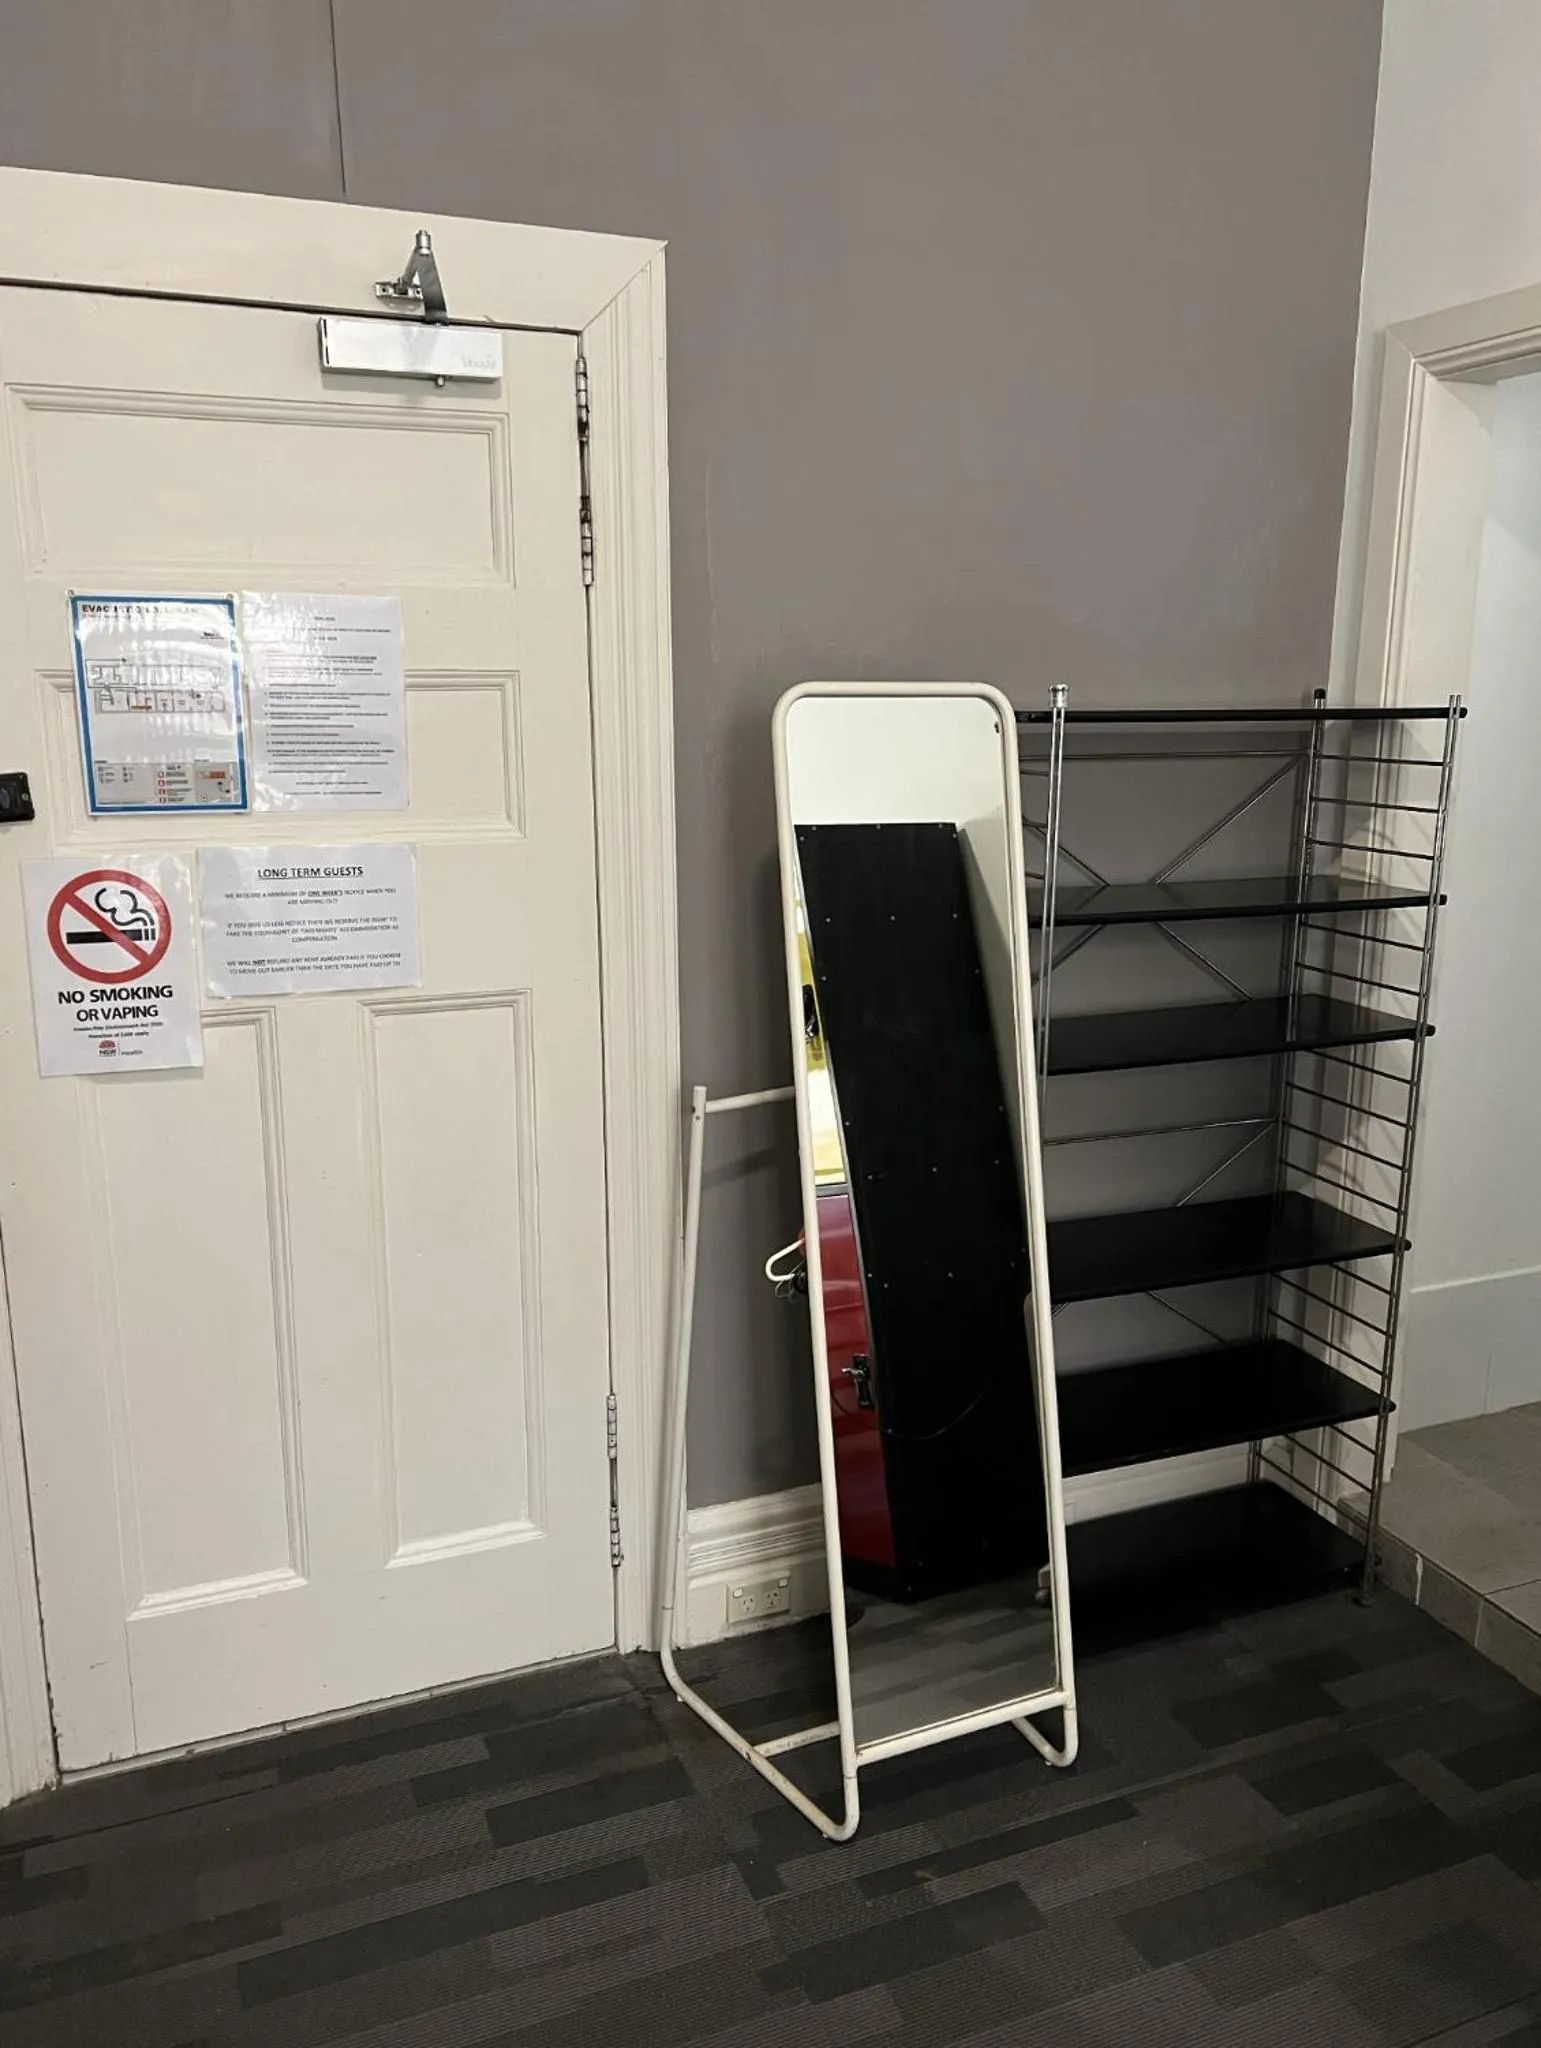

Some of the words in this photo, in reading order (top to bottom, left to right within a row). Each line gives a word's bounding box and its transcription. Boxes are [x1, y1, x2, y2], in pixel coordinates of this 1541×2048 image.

[257, 868, 288, 879] LONG
[290, 867, 321, 878] TERM
[323, 866, 364, 876] GUESTS
[58, 990, 85, 1004] NO
[89, 985, 173, 1003] SMOKING
[76, 1008, 99, 1022] OR
[101, 1004, 159, 1020] VAPING
